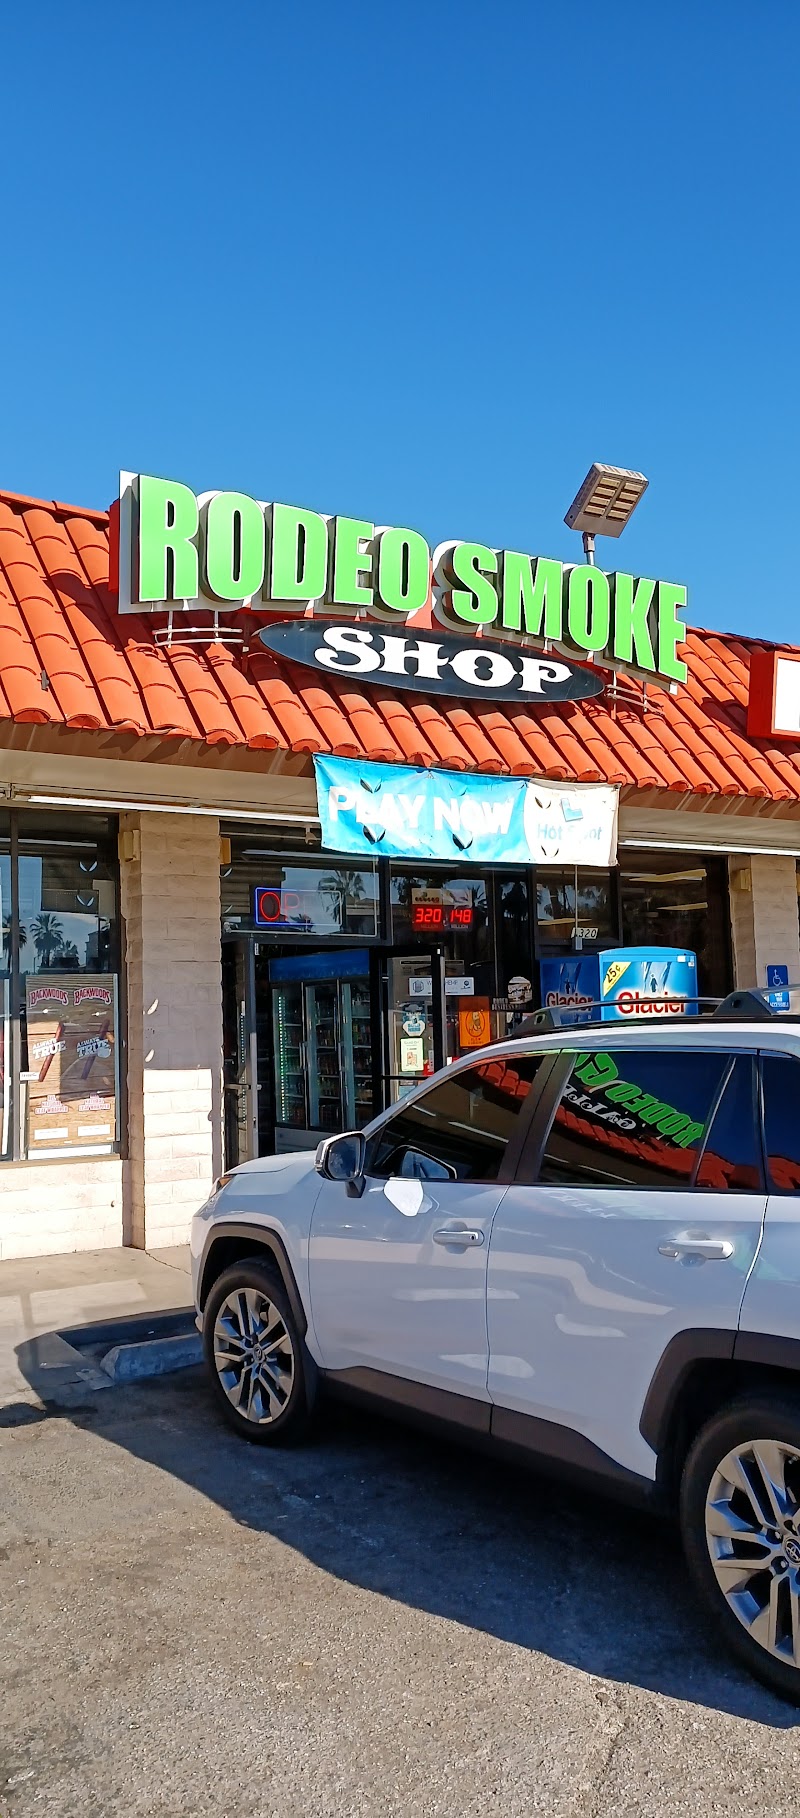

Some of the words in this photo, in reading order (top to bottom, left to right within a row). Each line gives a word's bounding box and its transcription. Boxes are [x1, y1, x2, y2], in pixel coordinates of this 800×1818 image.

[138, 474, 431, 613] RODEO
[452, 541, 688, 684] SMOKE
[314, 626, 574, 694] SHOP
[328, 785, 426, 829] PLAY
[433, 796, 515, 835] NOW
[537, 824, 563, 840] Hot
[415, 908, 441, 923] 320
[450, 909, 472, 923] 148
[30, 988, 68, 1006] BACKWOODS
[74, 987, 111, 1005] BACKWOODS
[546, 992, 594, 1011] Glacier
[617, 991, 687, 1014] Glacier
[33, 1040, 66, 1059] TRUE
[77, 1037, 100, 1049] ALWAYS
[77, 1039, 109, 1058] TRUE
